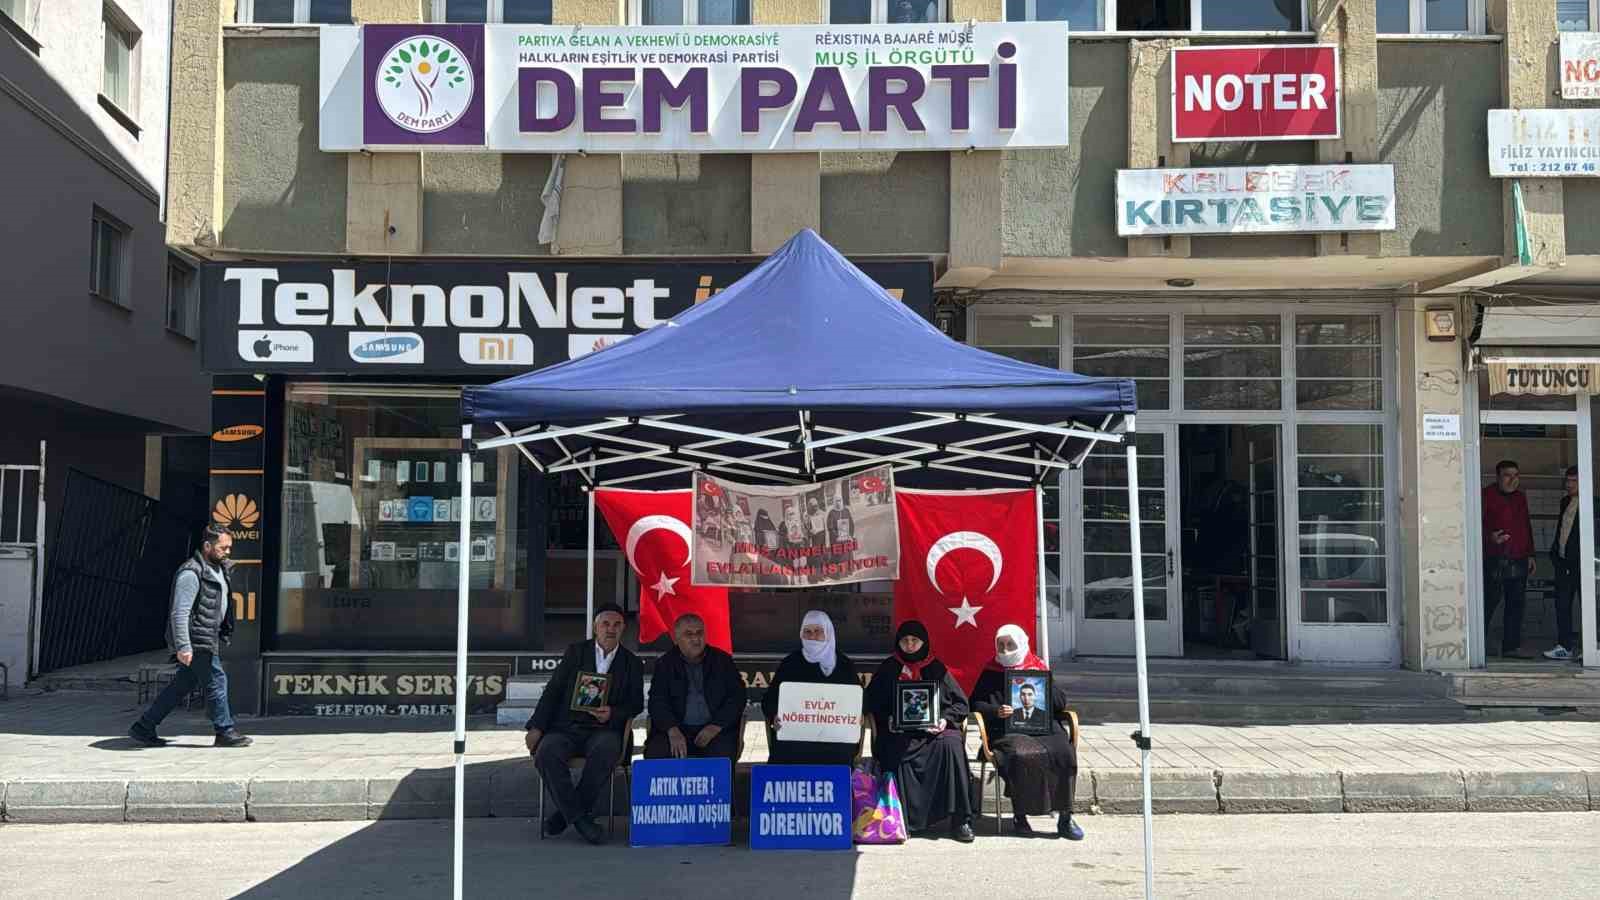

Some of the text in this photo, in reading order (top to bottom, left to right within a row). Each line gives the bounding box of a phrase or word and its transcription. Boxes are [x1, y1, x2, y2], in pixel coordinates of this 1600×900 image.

[518, 35, 565, 46] PARTIYA
[569, 35, 610, 46] GELAN
[614, 36, 623, 46] A
[884, 31, 934, 44] BAJARÊ
[519, 50, 780, 64] HALKLARIN EŞİTLİK VE DEMOKRASİ PARTİSİ
[815, 48, 975, 67] MUŞ İL ÖRGÜTÜ
[518, 41, 1018, 133] DEM PARTİ
[1184, 73, 1328, 111] NOTER
[397, 109, 453, 128] DEM PARTİ
[1509, 163, 1528, 172] Tel
[1540, 163, 1561, 172] 212
[1126, 192, 1386, 225] KIRTASİYE
[224, 268, 671, 329] TeknoNet
[273, 344, 299, 352] iPhone
[361, 343, 412, 353] SAMSUNG
[1507, 364, 1590, 388] TÜTÜNCÜ
[220, 427, 257, 437] SAMSUNG
[315, 704, 386, 716] TELEFON
[804, 700, 836, 711] EVLAT
[783, 711, 857, 725] NÖBETİNDEYİZ
[649, 777, 678, 796] ARTIK
[680, 777, 708, 796] YETER
[763, 781, 834, 803] ANNELER
[631, 799, 731, 828] YAKAMIZDAN DÜŞÜN
[759, 808, 843, 836] DİRENİYOR
